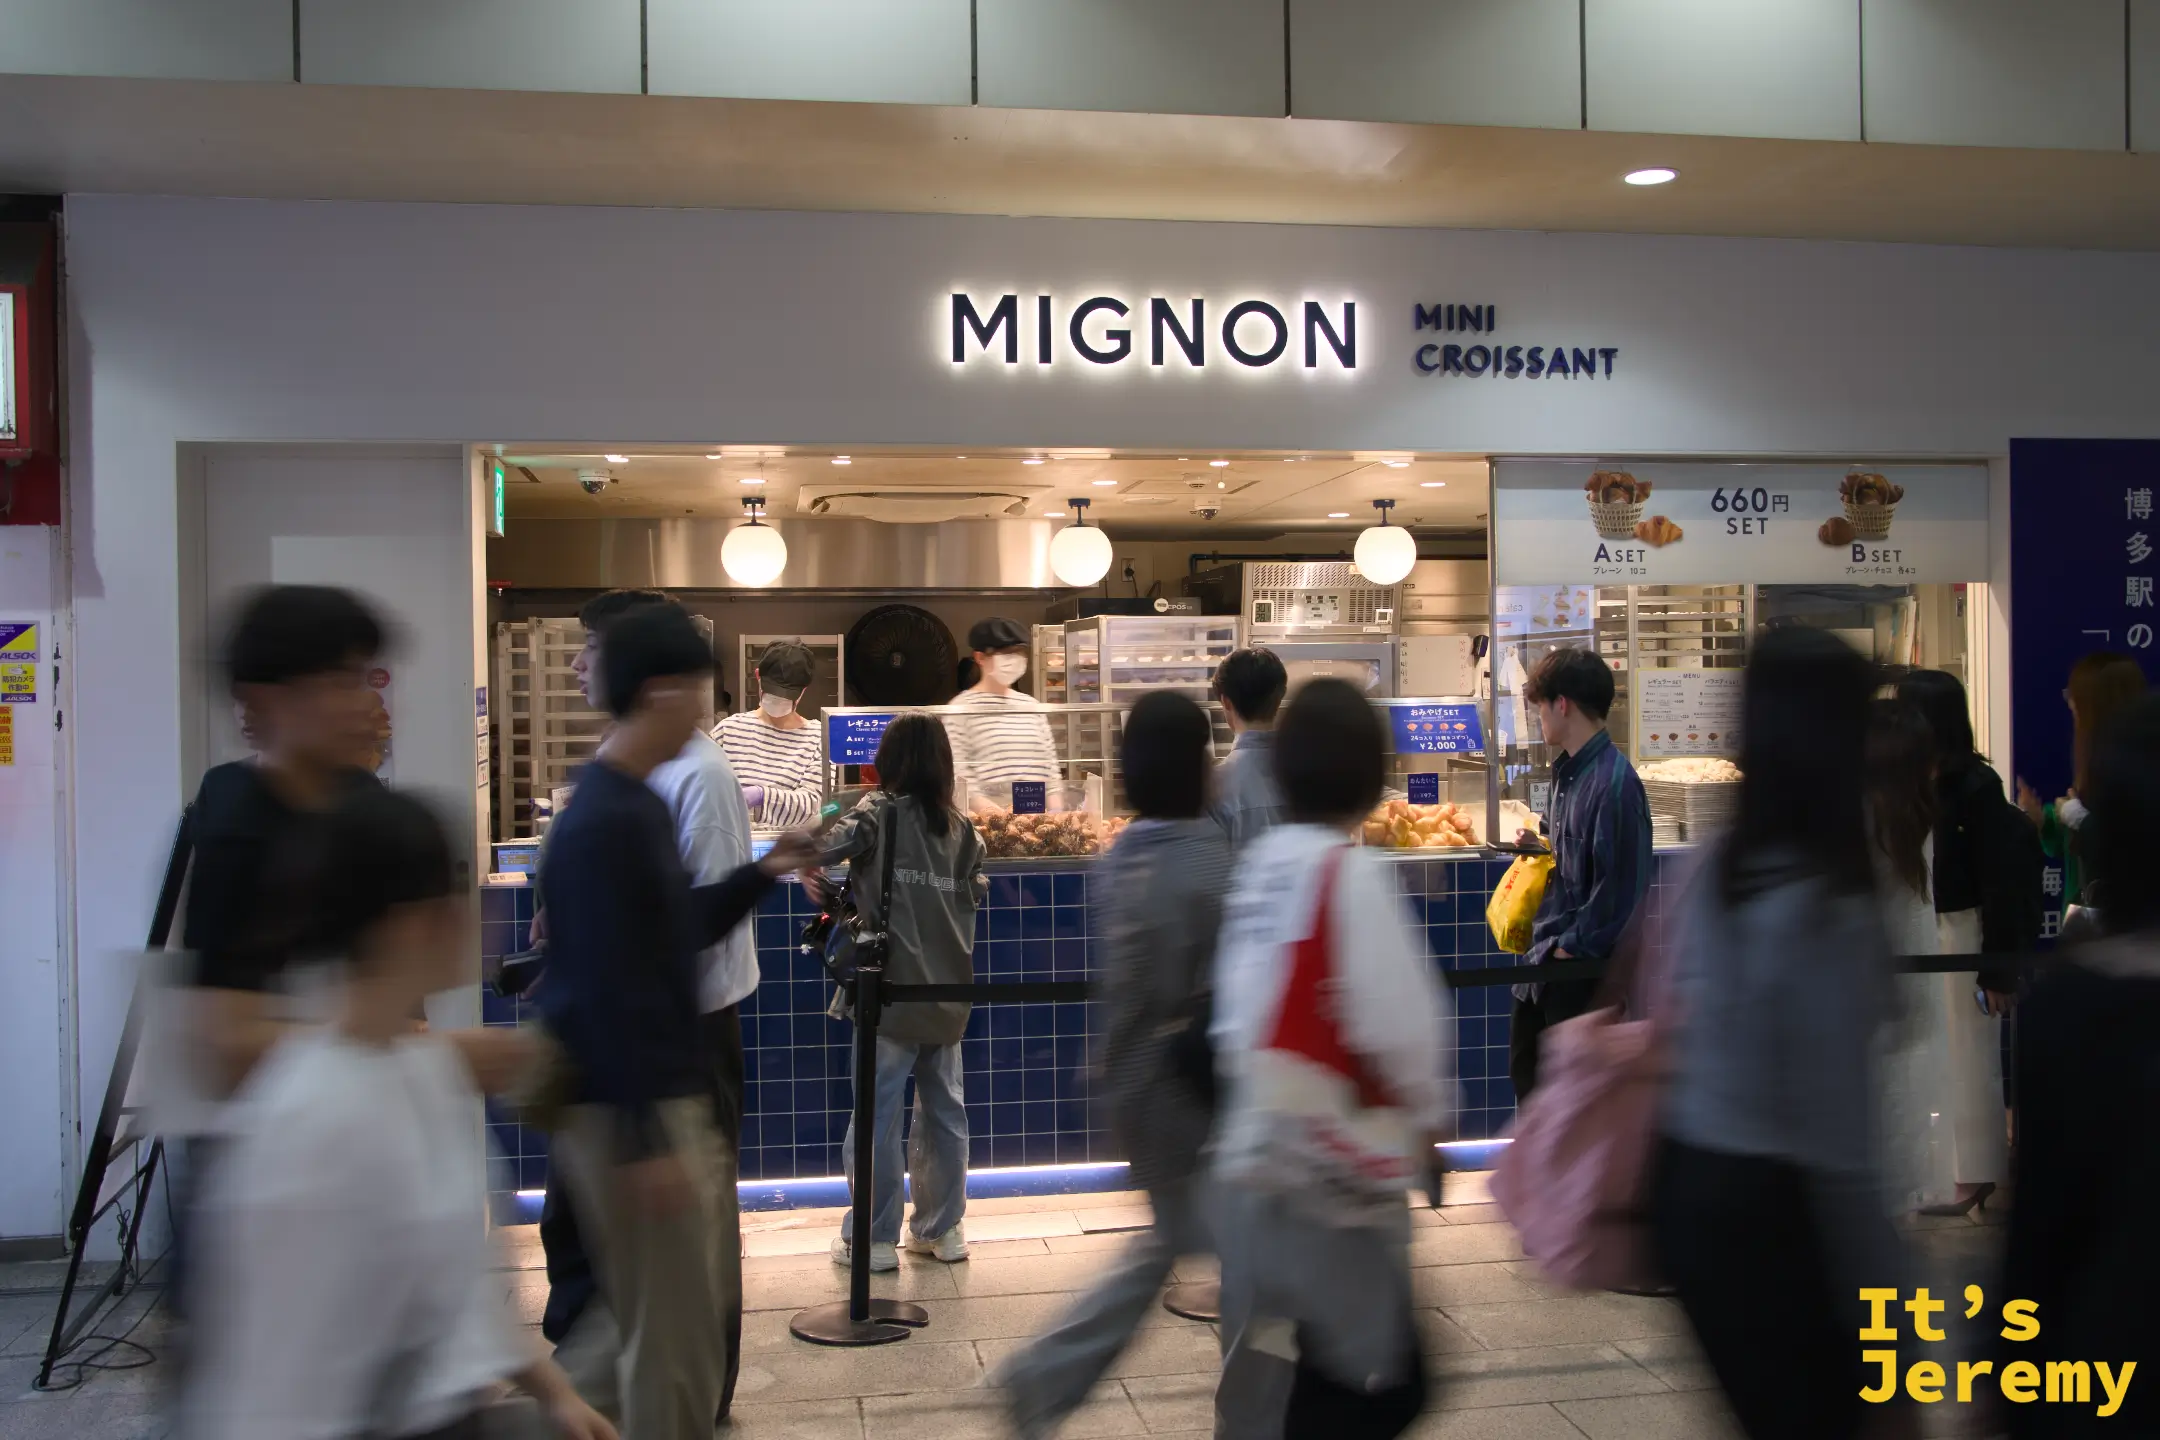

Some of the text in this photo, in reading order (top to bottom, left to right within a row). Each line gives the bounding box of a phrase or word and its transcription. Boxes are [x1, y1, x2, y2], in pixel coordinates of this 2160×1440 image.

[1414, 302, 1496, 332] MINI
[951, 293, 1357, 369] MIGNON
[1415, 343, 1619, 378] CROISSANT
[1710, 487, 1789, 513] 660円
[1726, 517, 1769, 535] SET
[1593, 543, 1647, 563] A SET
[1852, 543, 1903, 563] B SET
[1593, 566, 1647, 576] プレーン 10コ
[0, 652, 36, 660] ALSOK
[2, 675, 35, 684] 防犯カメラ
[8, 684, 30, 692] 作動中
[1420, 742, 1456, 750] ¥2,000
[1534, 784, 1539, 792] B
